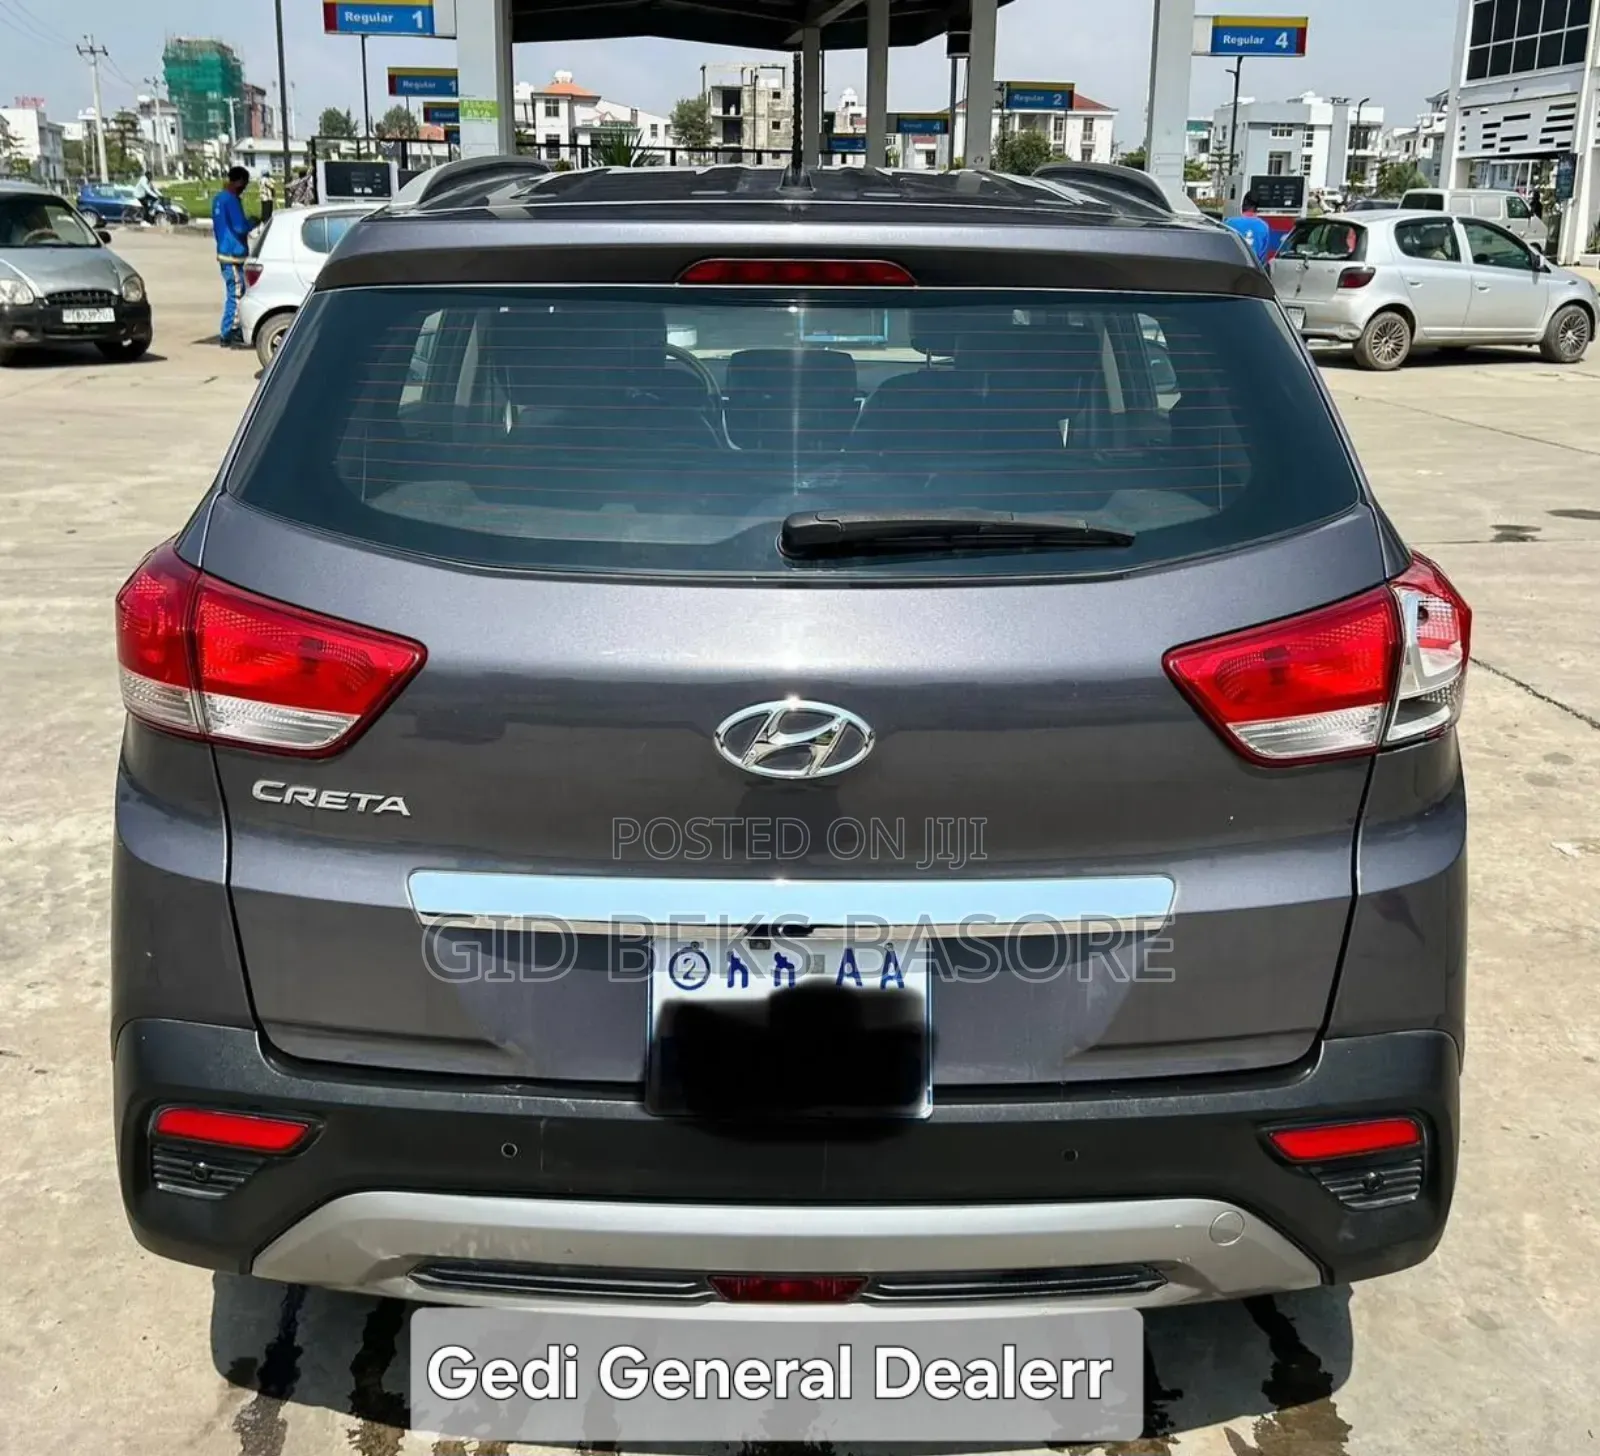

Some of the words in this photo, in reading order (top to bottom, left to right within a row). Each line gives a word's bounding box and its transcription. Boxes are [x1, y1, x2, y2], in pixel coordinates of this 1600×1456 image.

[344, 11, 394, 25] Regular
[412, 10, 423, 29] 1
[1223, 34, 1265, 46] Regular
[1275, 31, 1289, 49] 4
[449, 80, 457, 93] 1
[1053, 93, 1063, 106] 2
[252, 779, 411, 817] CRETA
